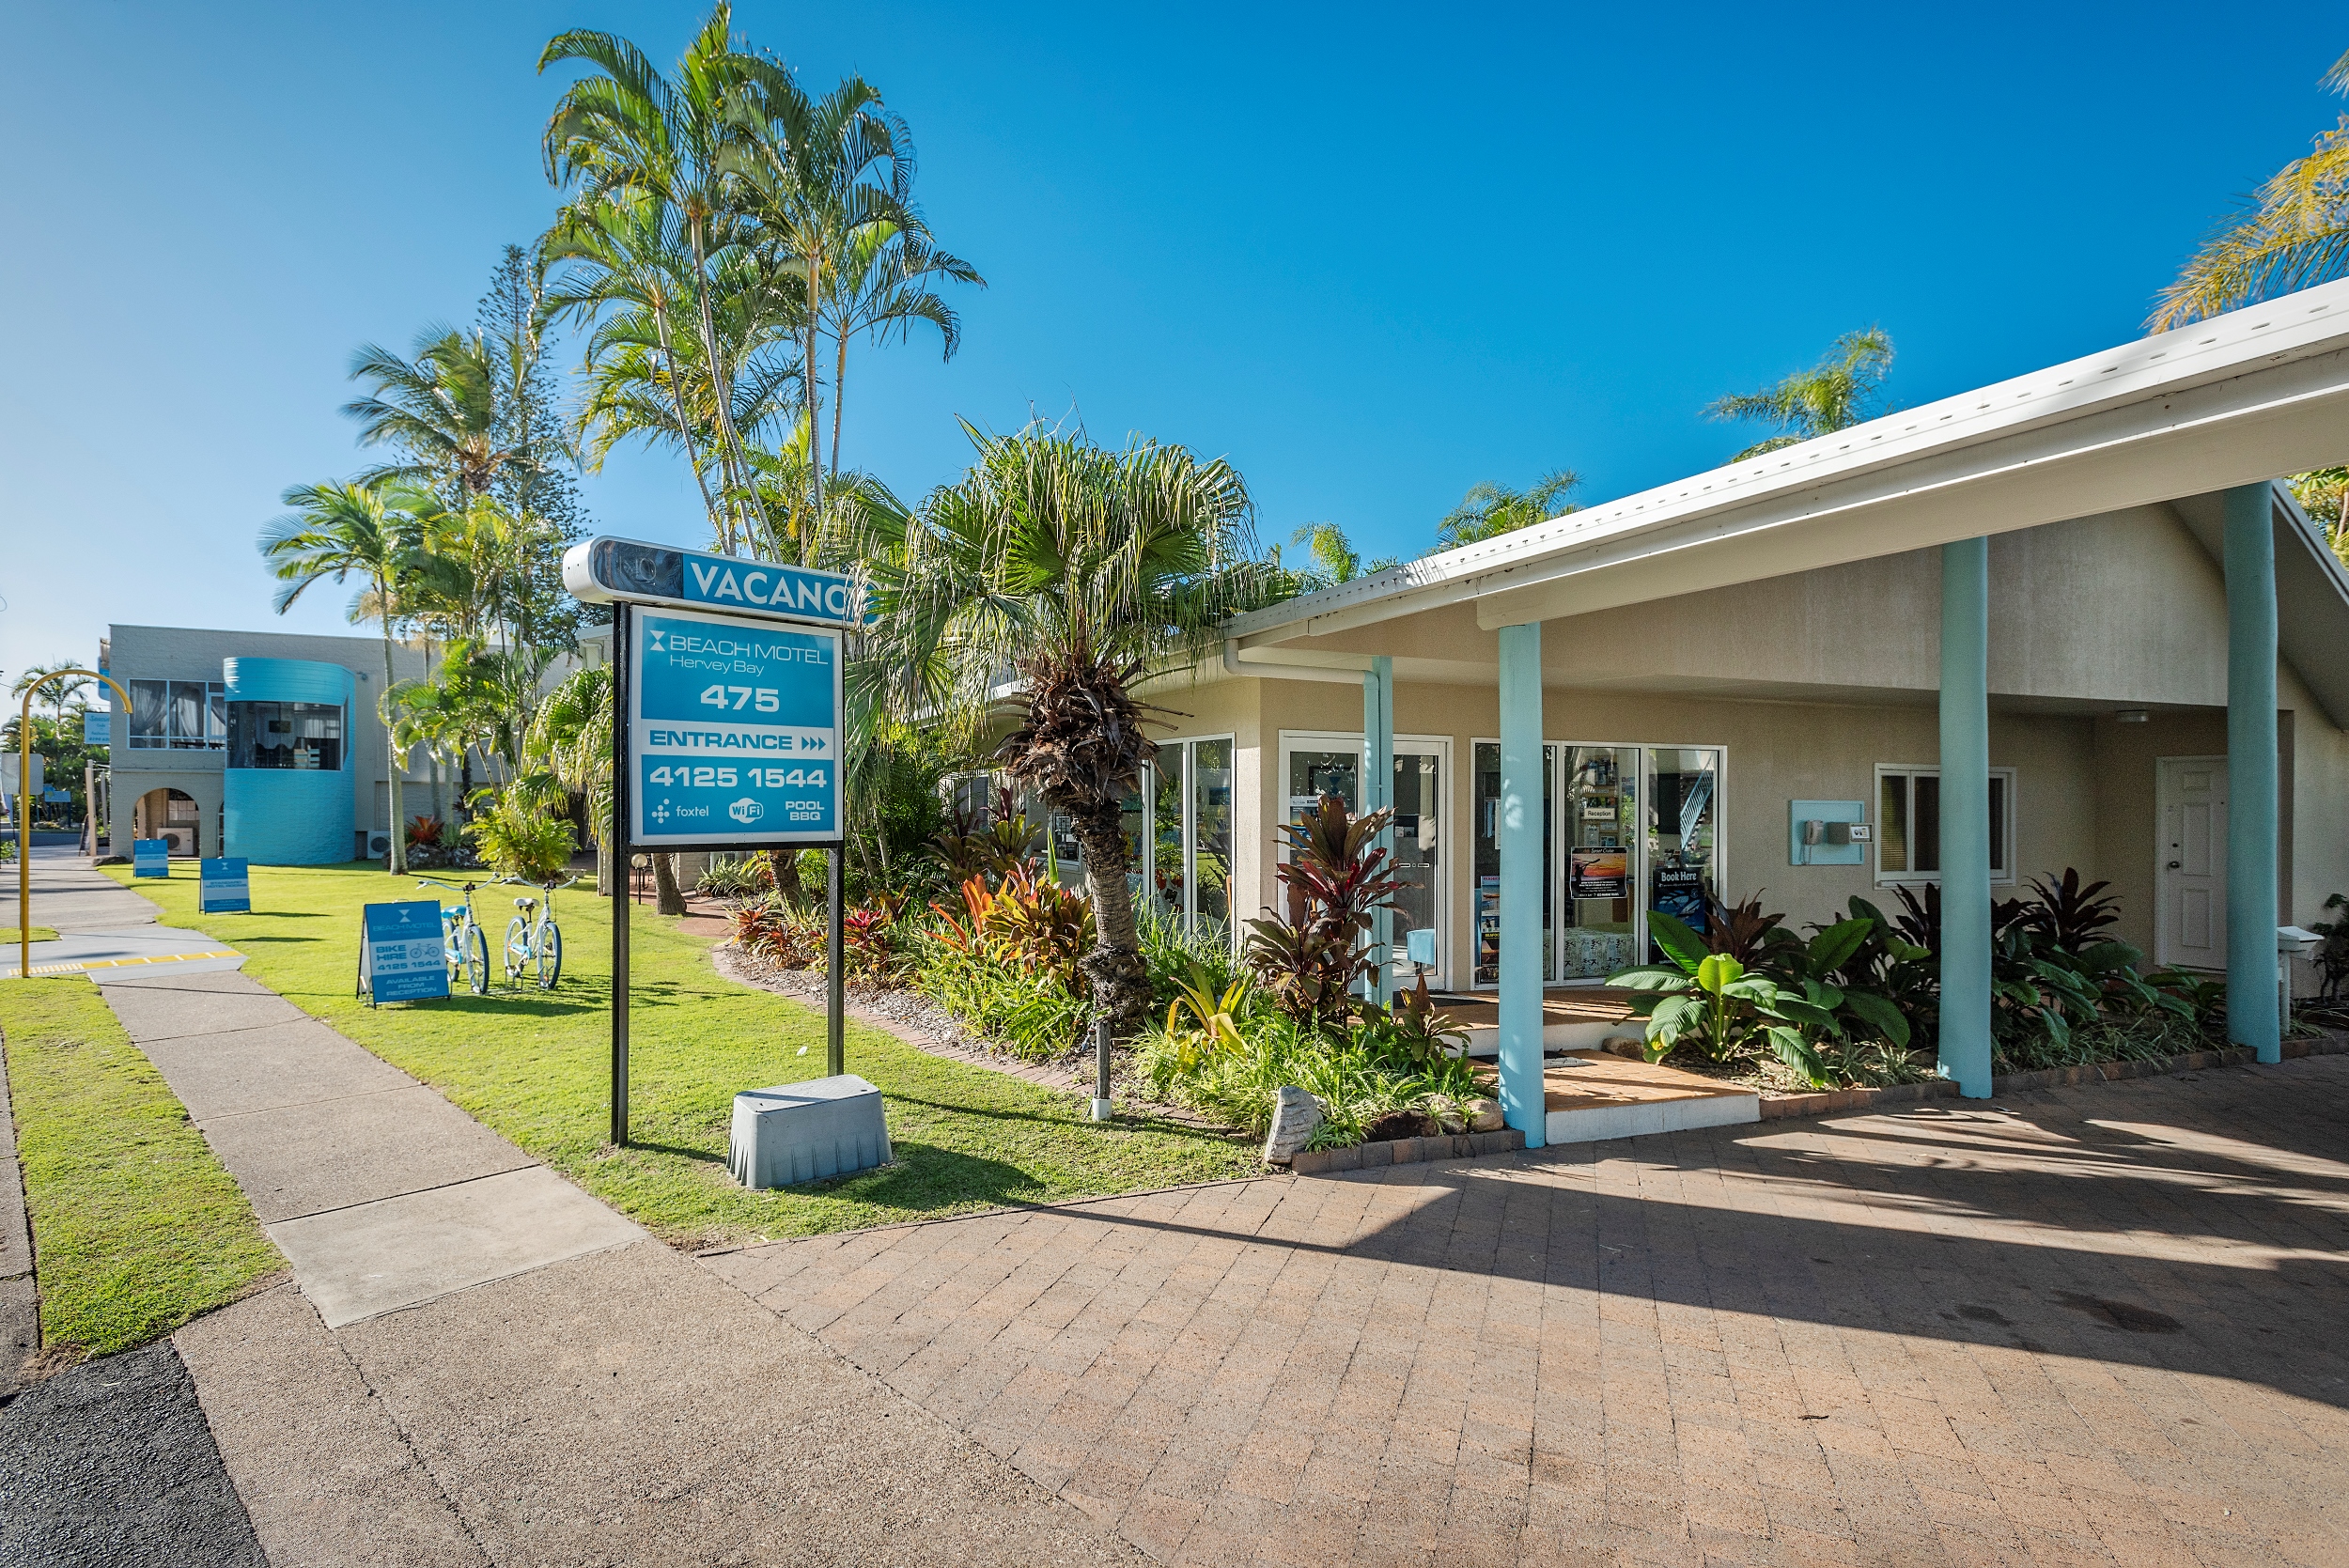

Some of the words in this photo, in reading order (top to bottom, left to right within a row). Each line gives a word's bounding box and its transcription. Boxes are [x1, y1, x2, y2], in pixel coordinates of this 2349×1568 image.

[690, 562, 860, 616] VACANC
[670, 635, 751, 658] BEACH
[754, 644, 829, 665] MOTEL
[670, 655, 731, 675] Hervey
[734, 661, 765, 676] Bay
[700, 684, 780, 712] 475
[649, 729, 793, 751] ENTRANCE
[649, 766, 739, 787] 4125
[747, 767, 827, 788] 1544
[676, 805, 709, 817] foxtel
[785, 800, 825, 811] POOL
[789, 811, 821, 821] BBQ
[1661, 871, 1680, 882] Book
[1680, 871, 1697, 881] Here
[376, 945, 406, 953] BIKE
[377, 953, 407, 961] HIRE
[386, 976, 435, 985] AVAILABLE
[387, 987, 436, 996] RECEPTION
